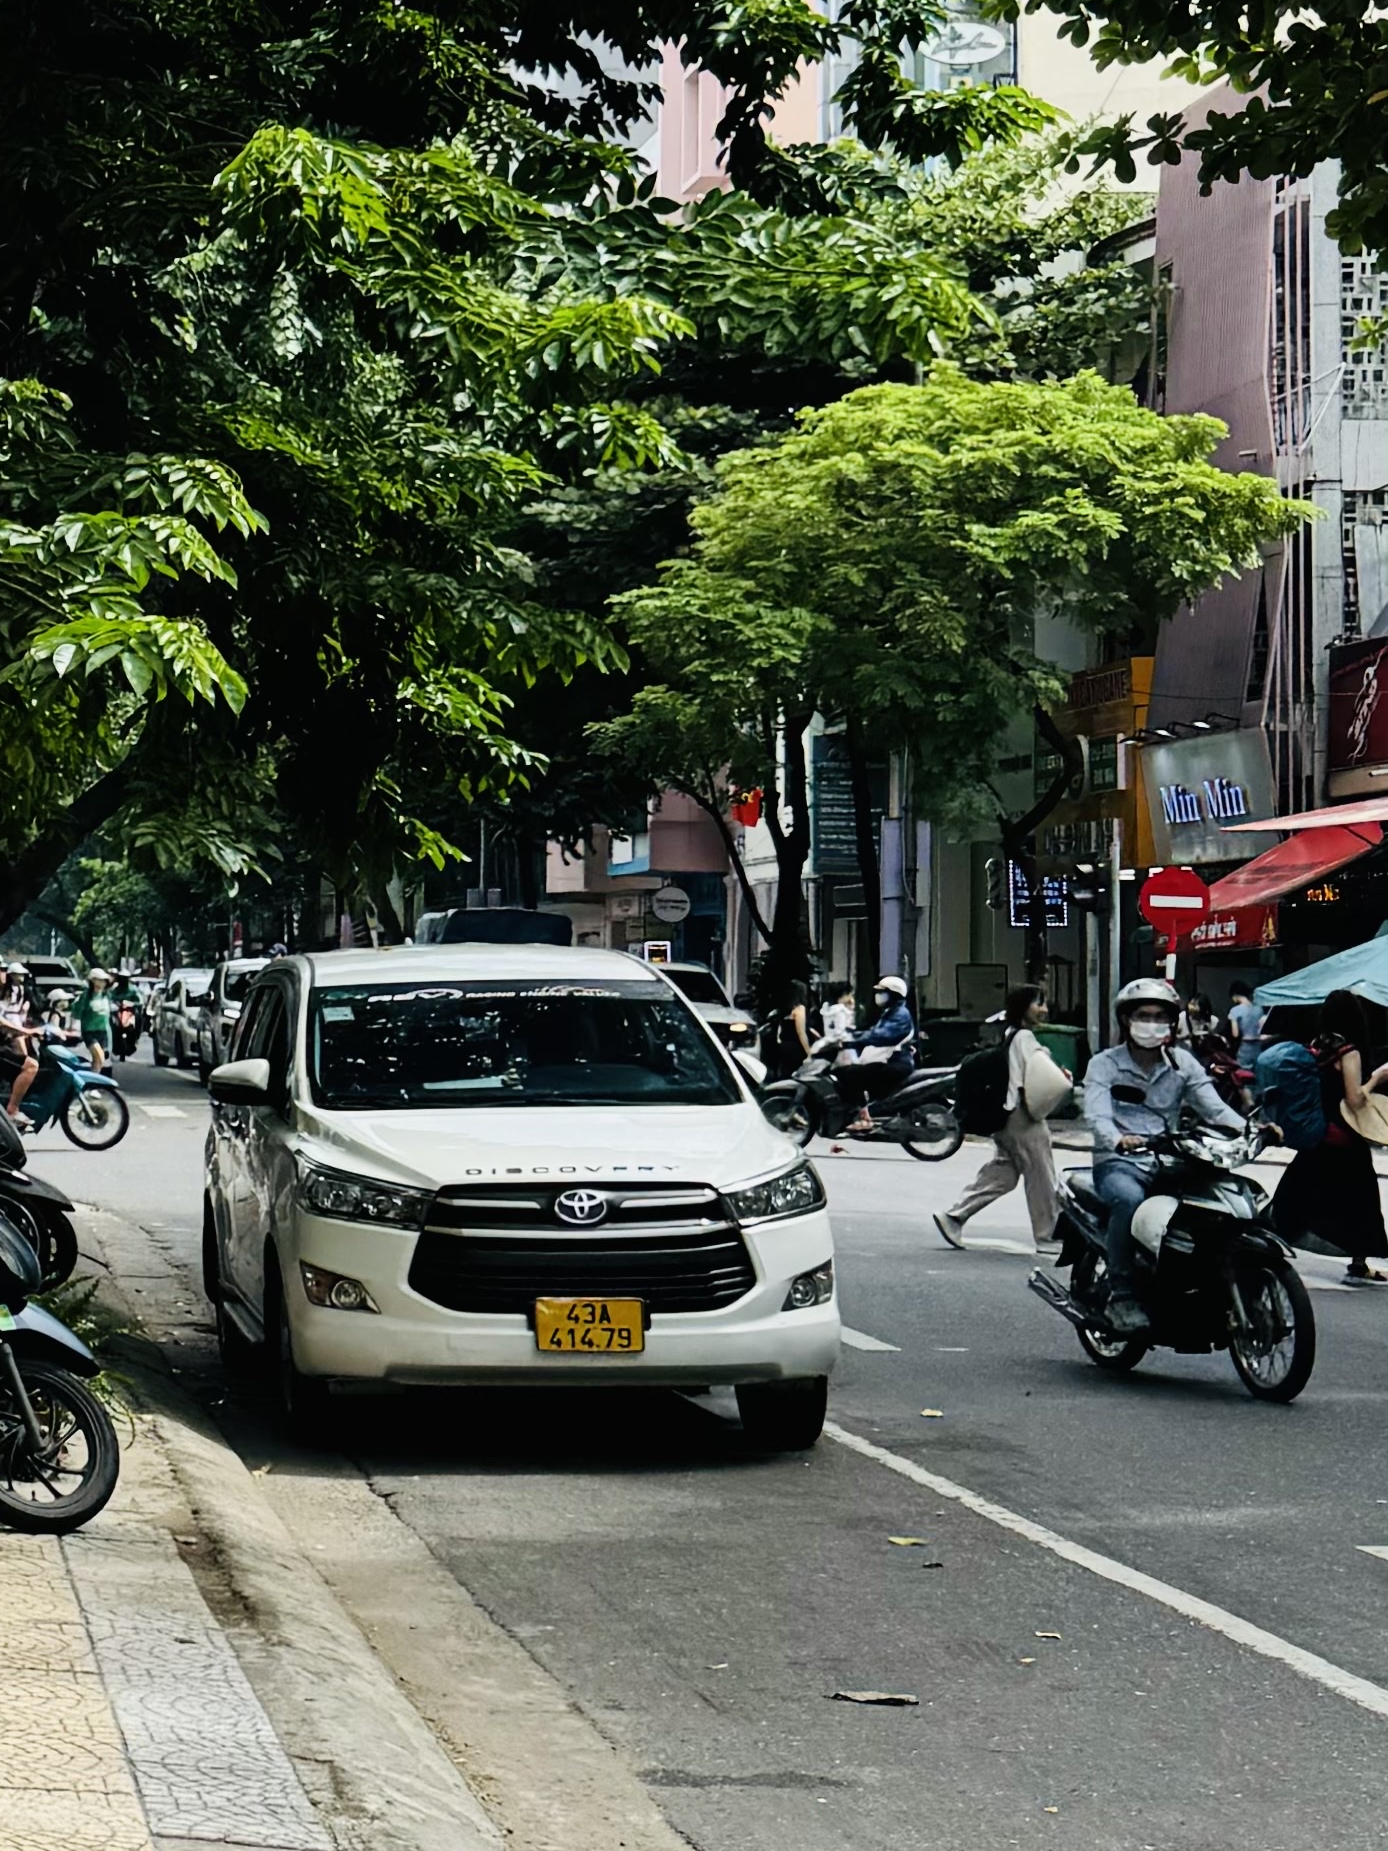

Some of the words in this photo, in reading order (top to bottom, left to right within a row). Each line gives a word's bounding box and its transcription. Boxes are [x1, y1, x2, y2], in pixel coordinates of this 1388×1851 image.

[1160, 785, 1201, 823] Min
[1204, 778, 1246, 818] Min
[567, 1303, 612, 1325] 43A
[549, 1327, 632, 1349] 414.79
